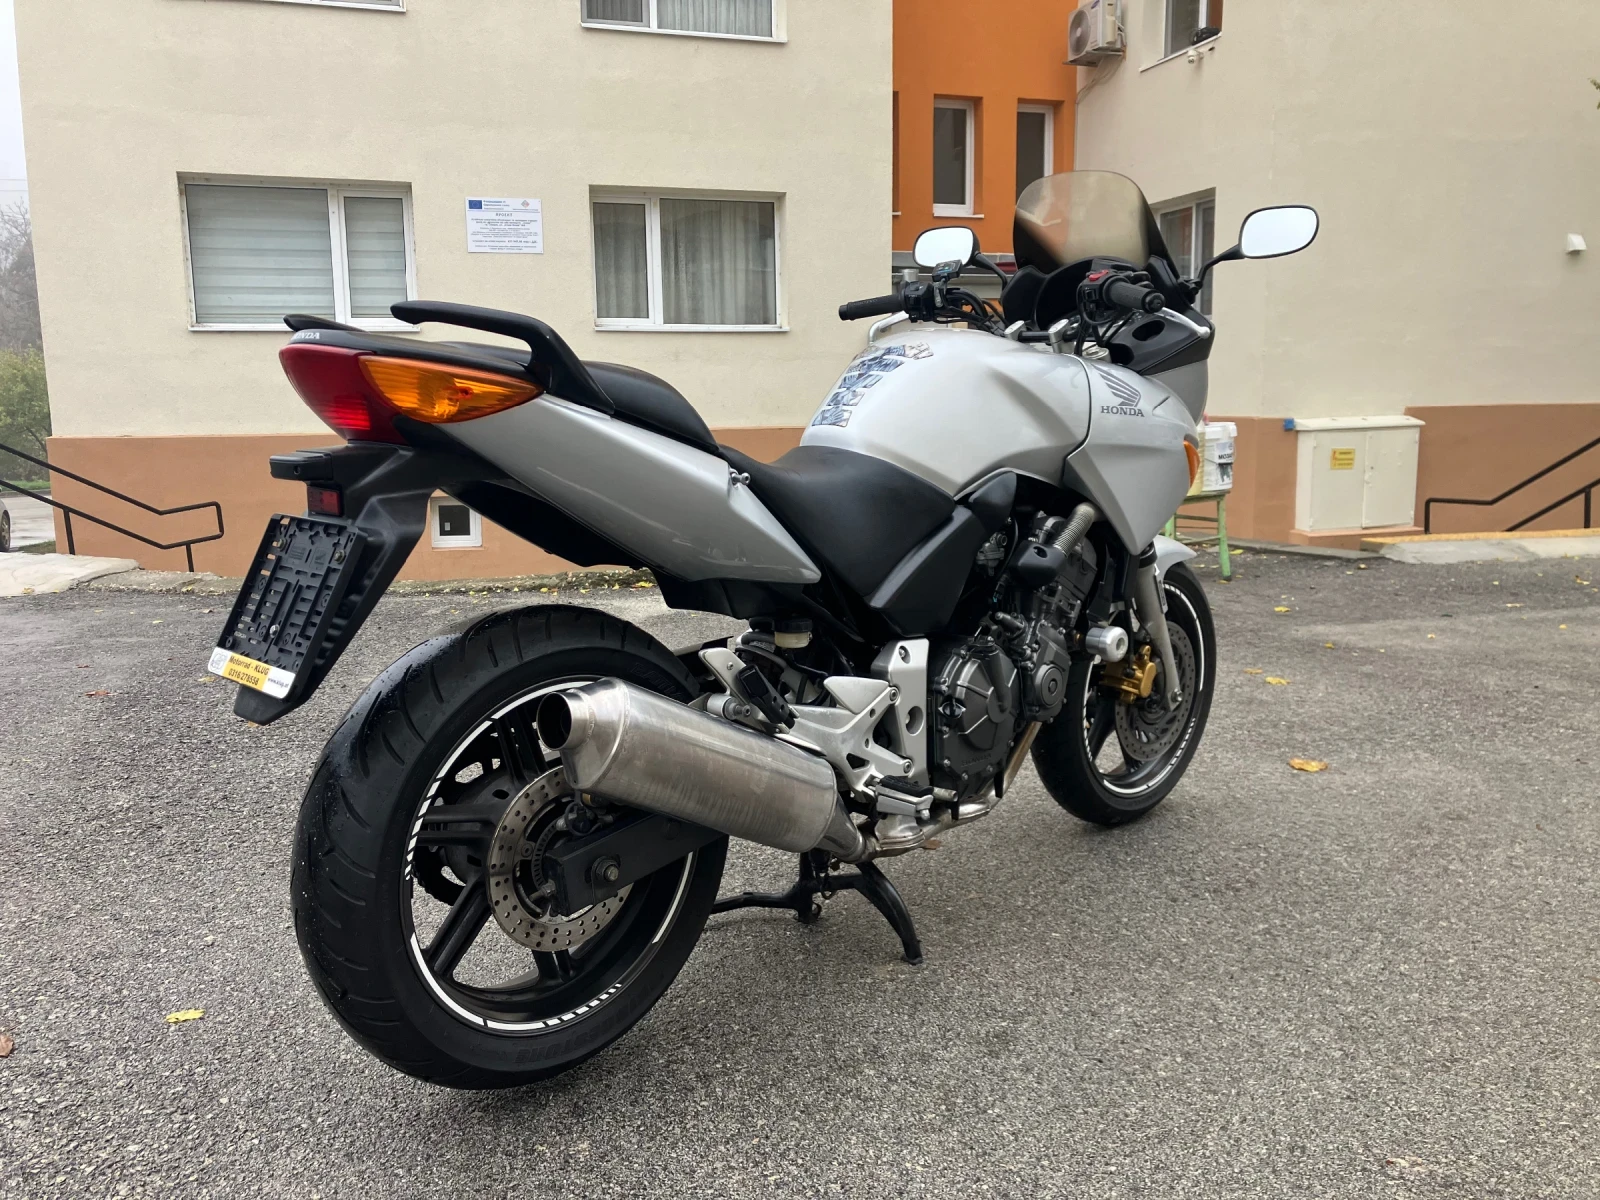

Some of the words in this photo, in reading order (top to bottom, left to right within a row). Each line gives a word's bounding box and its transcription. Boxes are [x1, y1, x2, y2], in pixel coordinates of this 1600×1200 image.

[1101, 405, 1145, 417] HONDA
[229, 655, 251, 669] Motorrad
[254, 664, 270, 676] KLUG
